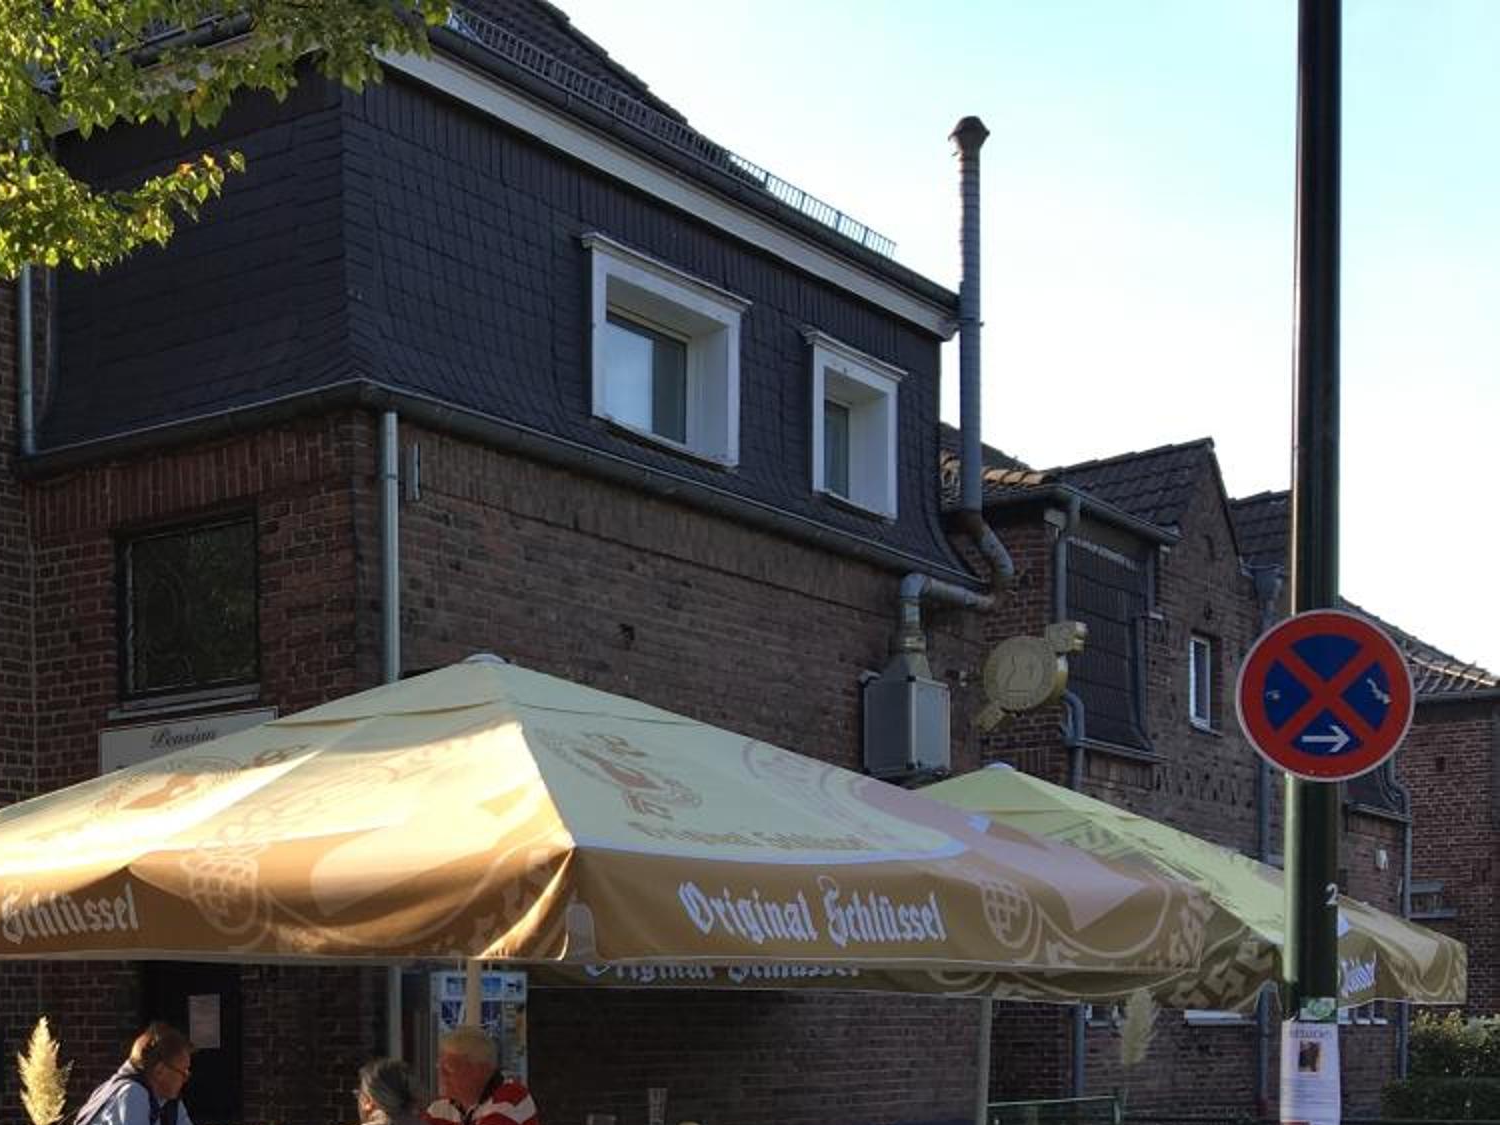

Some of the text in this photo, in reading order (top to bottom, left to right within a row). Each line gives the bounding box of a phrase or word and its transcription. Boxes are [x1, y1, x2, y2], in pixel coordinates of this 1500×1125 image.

[2, 879, 140, 945] Schlüssel
[678, 874, 947, 948] Original Schlüssel
